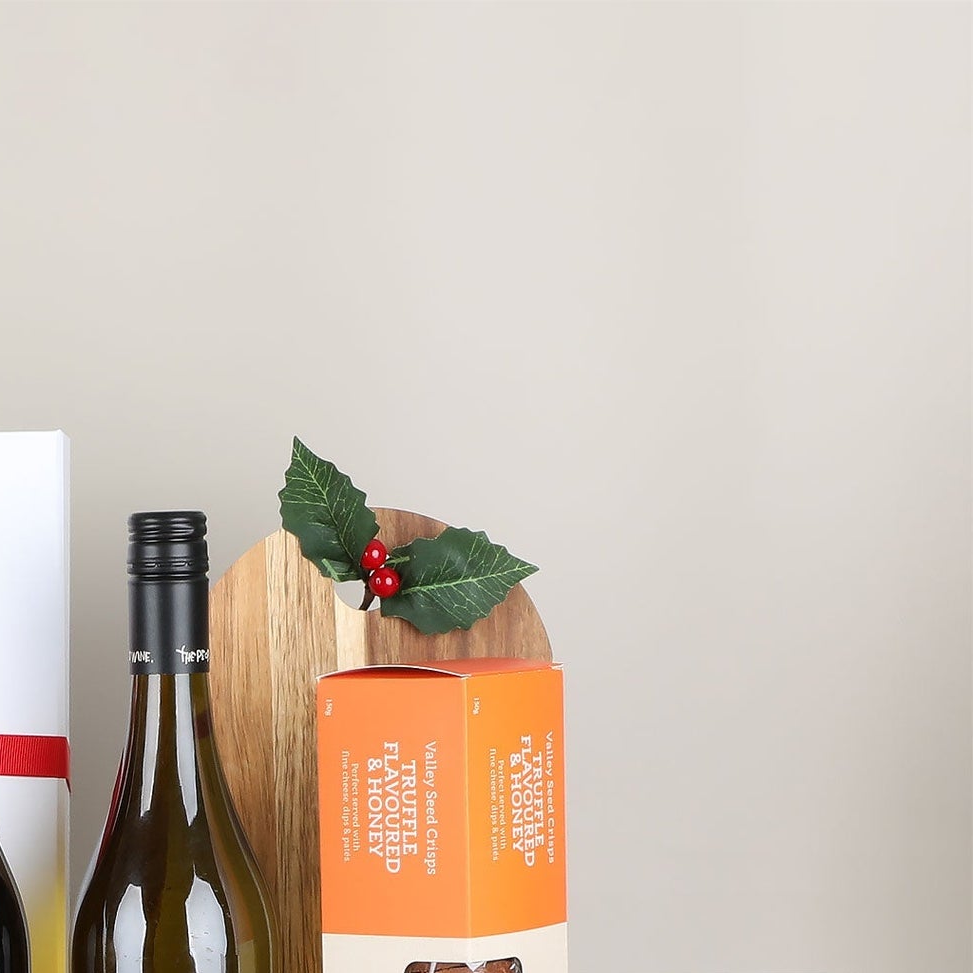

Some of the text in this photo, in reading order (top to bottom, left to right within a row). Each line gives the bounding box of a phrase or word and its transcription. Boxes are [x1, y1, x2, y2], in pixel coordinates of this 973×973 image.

[498, 759, 506, 790] Perfect
[521, 735, 535, 867] FLAVOURED
[532, 752, 545, 847] TRUFFLE
[545, 731, 553, 777] Valley
[547, 781, 555, 814] Seed
[342, 807, 351, 827] dips
[352, 763, 360, 852] Perfect served with
[367, 758, 383, 858] & HONEY
[383, 741, 401, 873] FLAVOURED
[401, 759, 418, 855] TRUFFLE
[423, 740, 439, 875] Valley Seed Crisps
[498, 791, 506, 822] served
[510, 753, 523, 853] & HONEY
